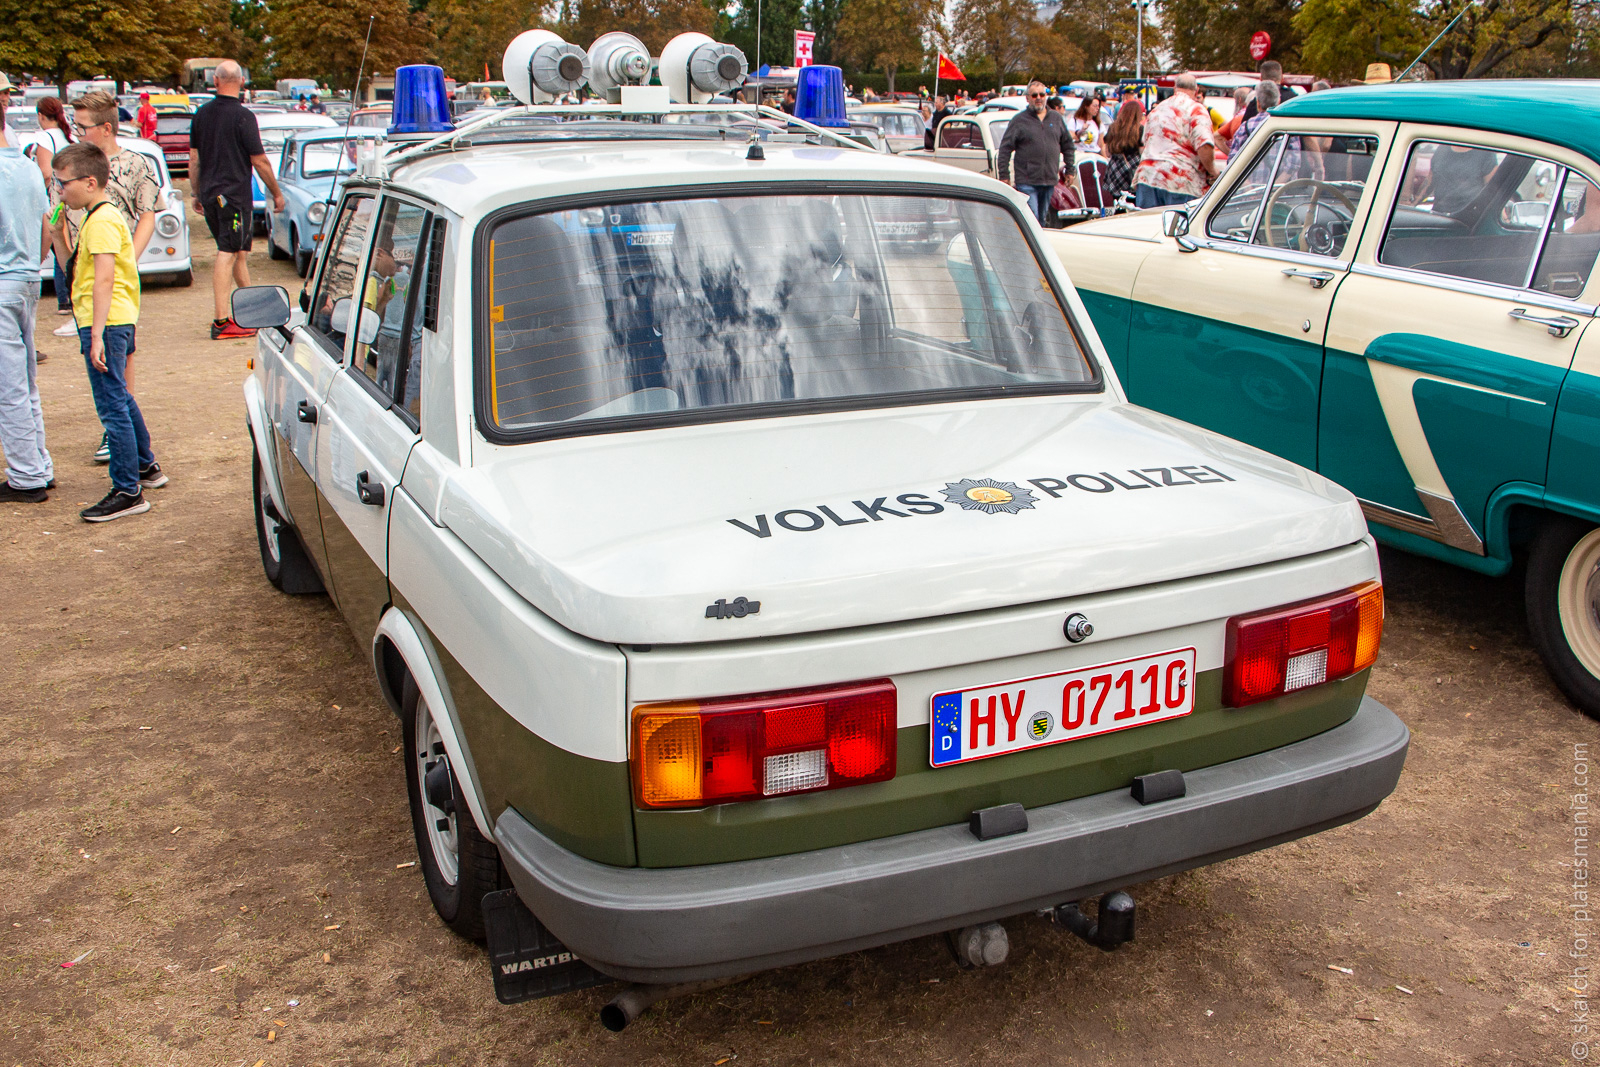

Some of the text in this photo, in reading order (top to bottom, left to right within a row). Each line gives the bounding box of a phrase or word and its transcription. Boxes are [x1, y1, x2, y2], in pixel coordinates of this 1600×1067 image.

[726, 465, 1237, 539] VOLKS POLIZEI
[714, 596, 749, 620] 1.3
[969, 689, 1026, 750] HY
[1061, 659, 1188, 731] 07110
[941, 735, 953, 751] D
